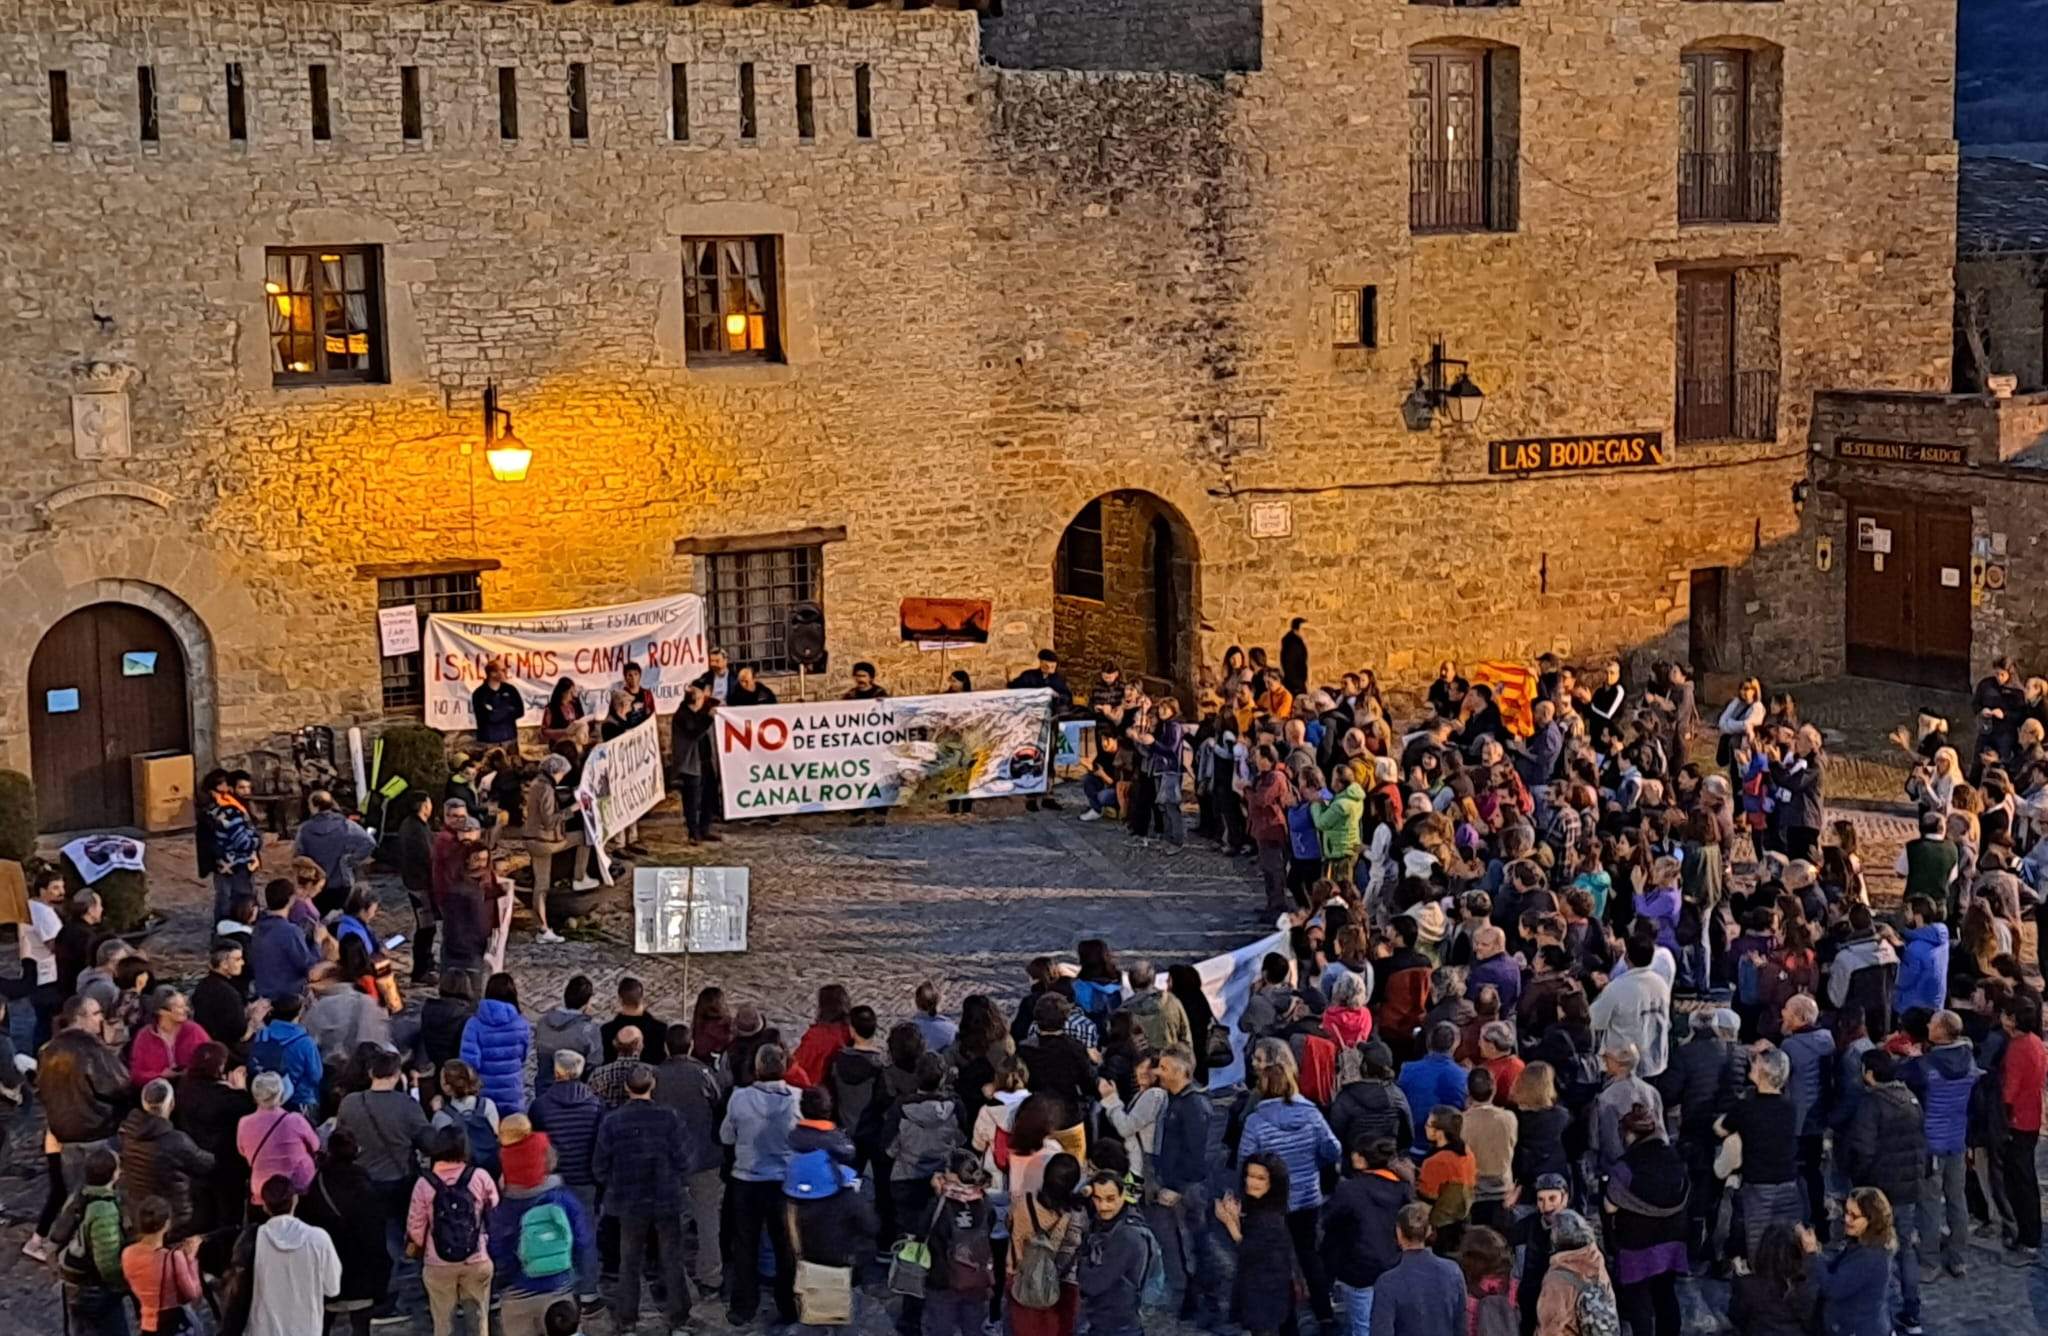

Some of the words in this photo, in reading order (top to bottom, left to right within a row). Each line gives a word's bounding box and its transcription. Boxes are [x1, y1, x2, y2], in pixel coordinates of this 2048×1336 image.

[1501, 443, 1541, 470] LAS
[1550, 438, 1645, 467] BODEGAS
[464, 622, 482, 636] NO
[582, 616, 594, 630] DE
[607, 608, 680, 629] ESTACIONES
[574, 645, 632, 674] CANAL
[647, 634, 705, 668] ROYA!
[434, 700, 448, 715] NO
[453, 701, 462, 714] A
[724, 717, 788, 754] NO
[792, 717, 804, 731] A
[810, 715, 830, 730] LA
[835, 708, 895, 729] UNIÓN
[793, 735, 815, 750] DE
[821, 726, 928, 748] ESTACIONES
[749, 759, 871, 784] SALVEMOS
[737, 787, 812, 809] CANAL
[819, 783, 882, 803] ROYA
